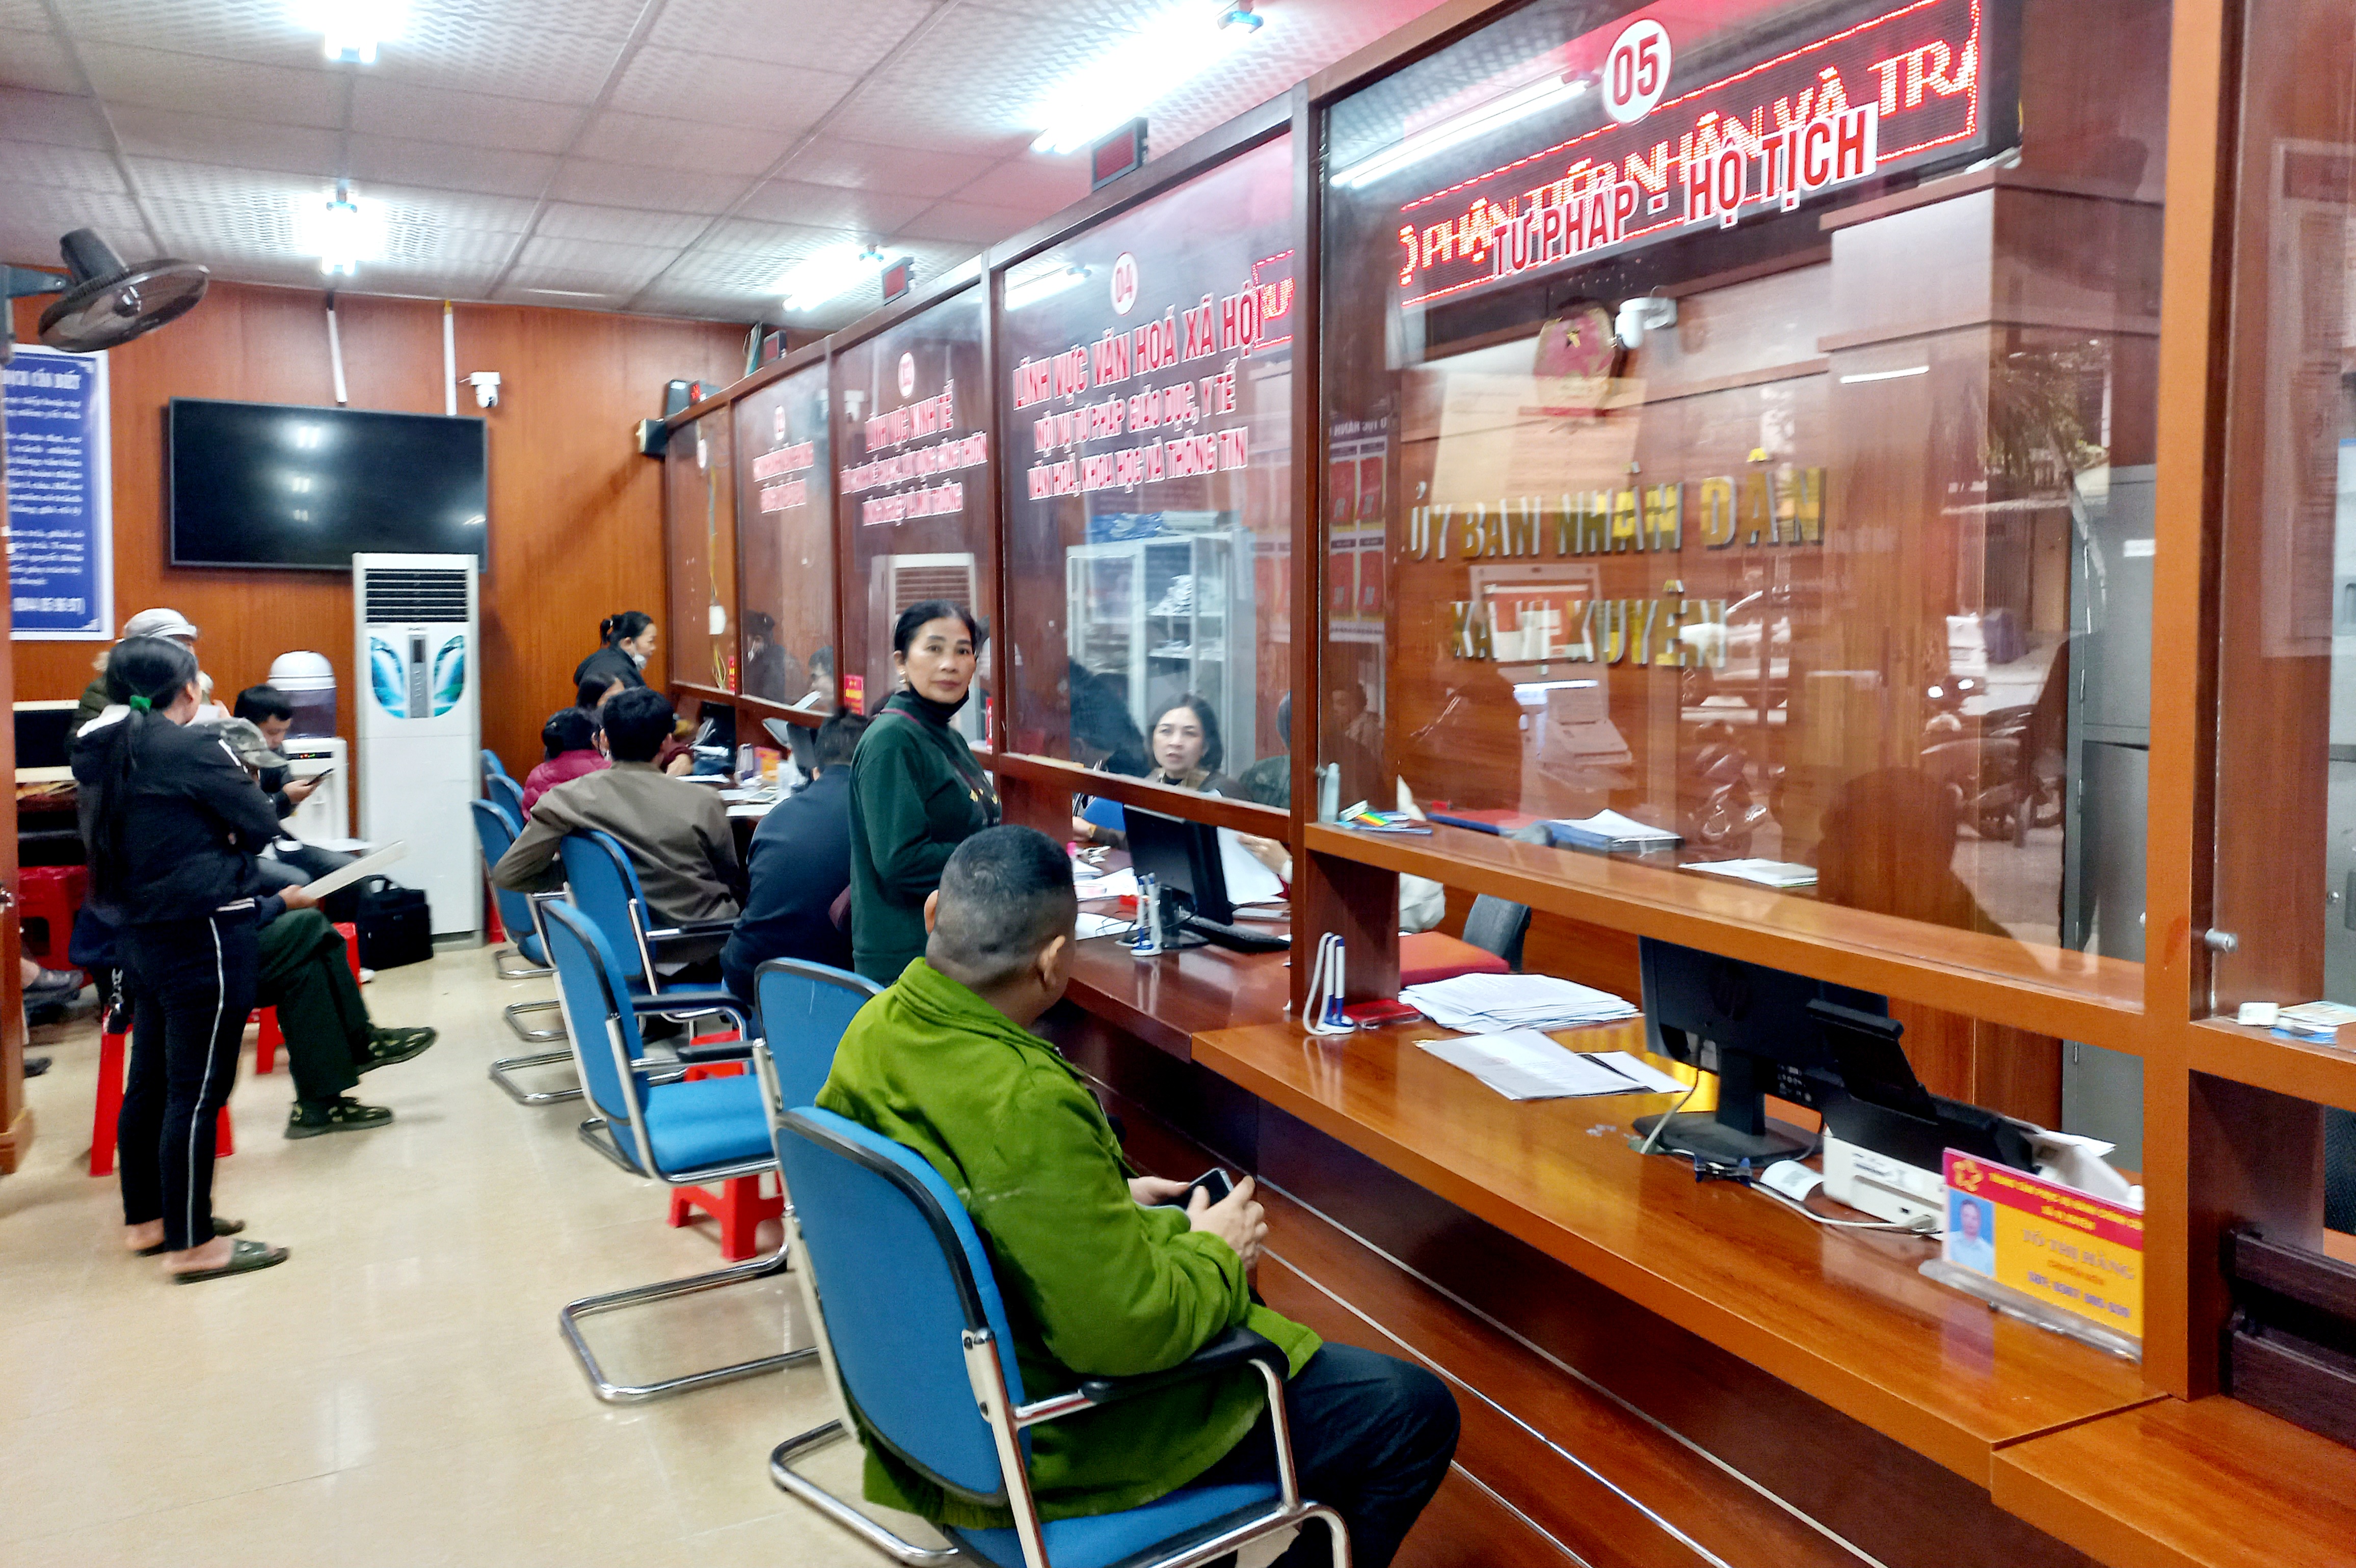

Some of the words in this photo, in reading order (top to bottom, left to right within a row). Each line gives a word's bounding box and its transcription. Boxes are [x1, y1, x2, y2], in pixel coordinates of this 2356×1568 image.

[1614, 33, 1659, 105] 05
[1773, 66, 1850, 129] VÀ
[1542, 177, 1639, 263] PHÁP
[1685, 137, 1747, 229] HỘ
[1761, 101, 1878, 212] TỊCH
[1115, 263, 1135, 303] 04
[1013, 356, 1051, 411] LĨNH
[1051, 344, 1088, 406] VỰC
[1090, 327, 1131, 388] VĂN
[1133, 304, 1178, 376] HOÁ
[1182, 292, 1217, 363] XÃ
[1220, 280, 1266, 359] HỘI
[1090, 392, 1126, 442] PHÁP
[1126, 383, 1162, 434] GIÁO
[1199, 376, 1214, 418] Y
[1213, 358, 1239, 416] TẾ
[1143, 435, 1166, 484] VÀ
[1164, 428, 1218, 480] THÔNG
[1217, 426, 1248, 472] TIN
[1555, 462, 1684, 554] NHÂN
[1700, 447, 1827, 546] DÂN
[1566, 580, 1727, 667] XUYÊN
